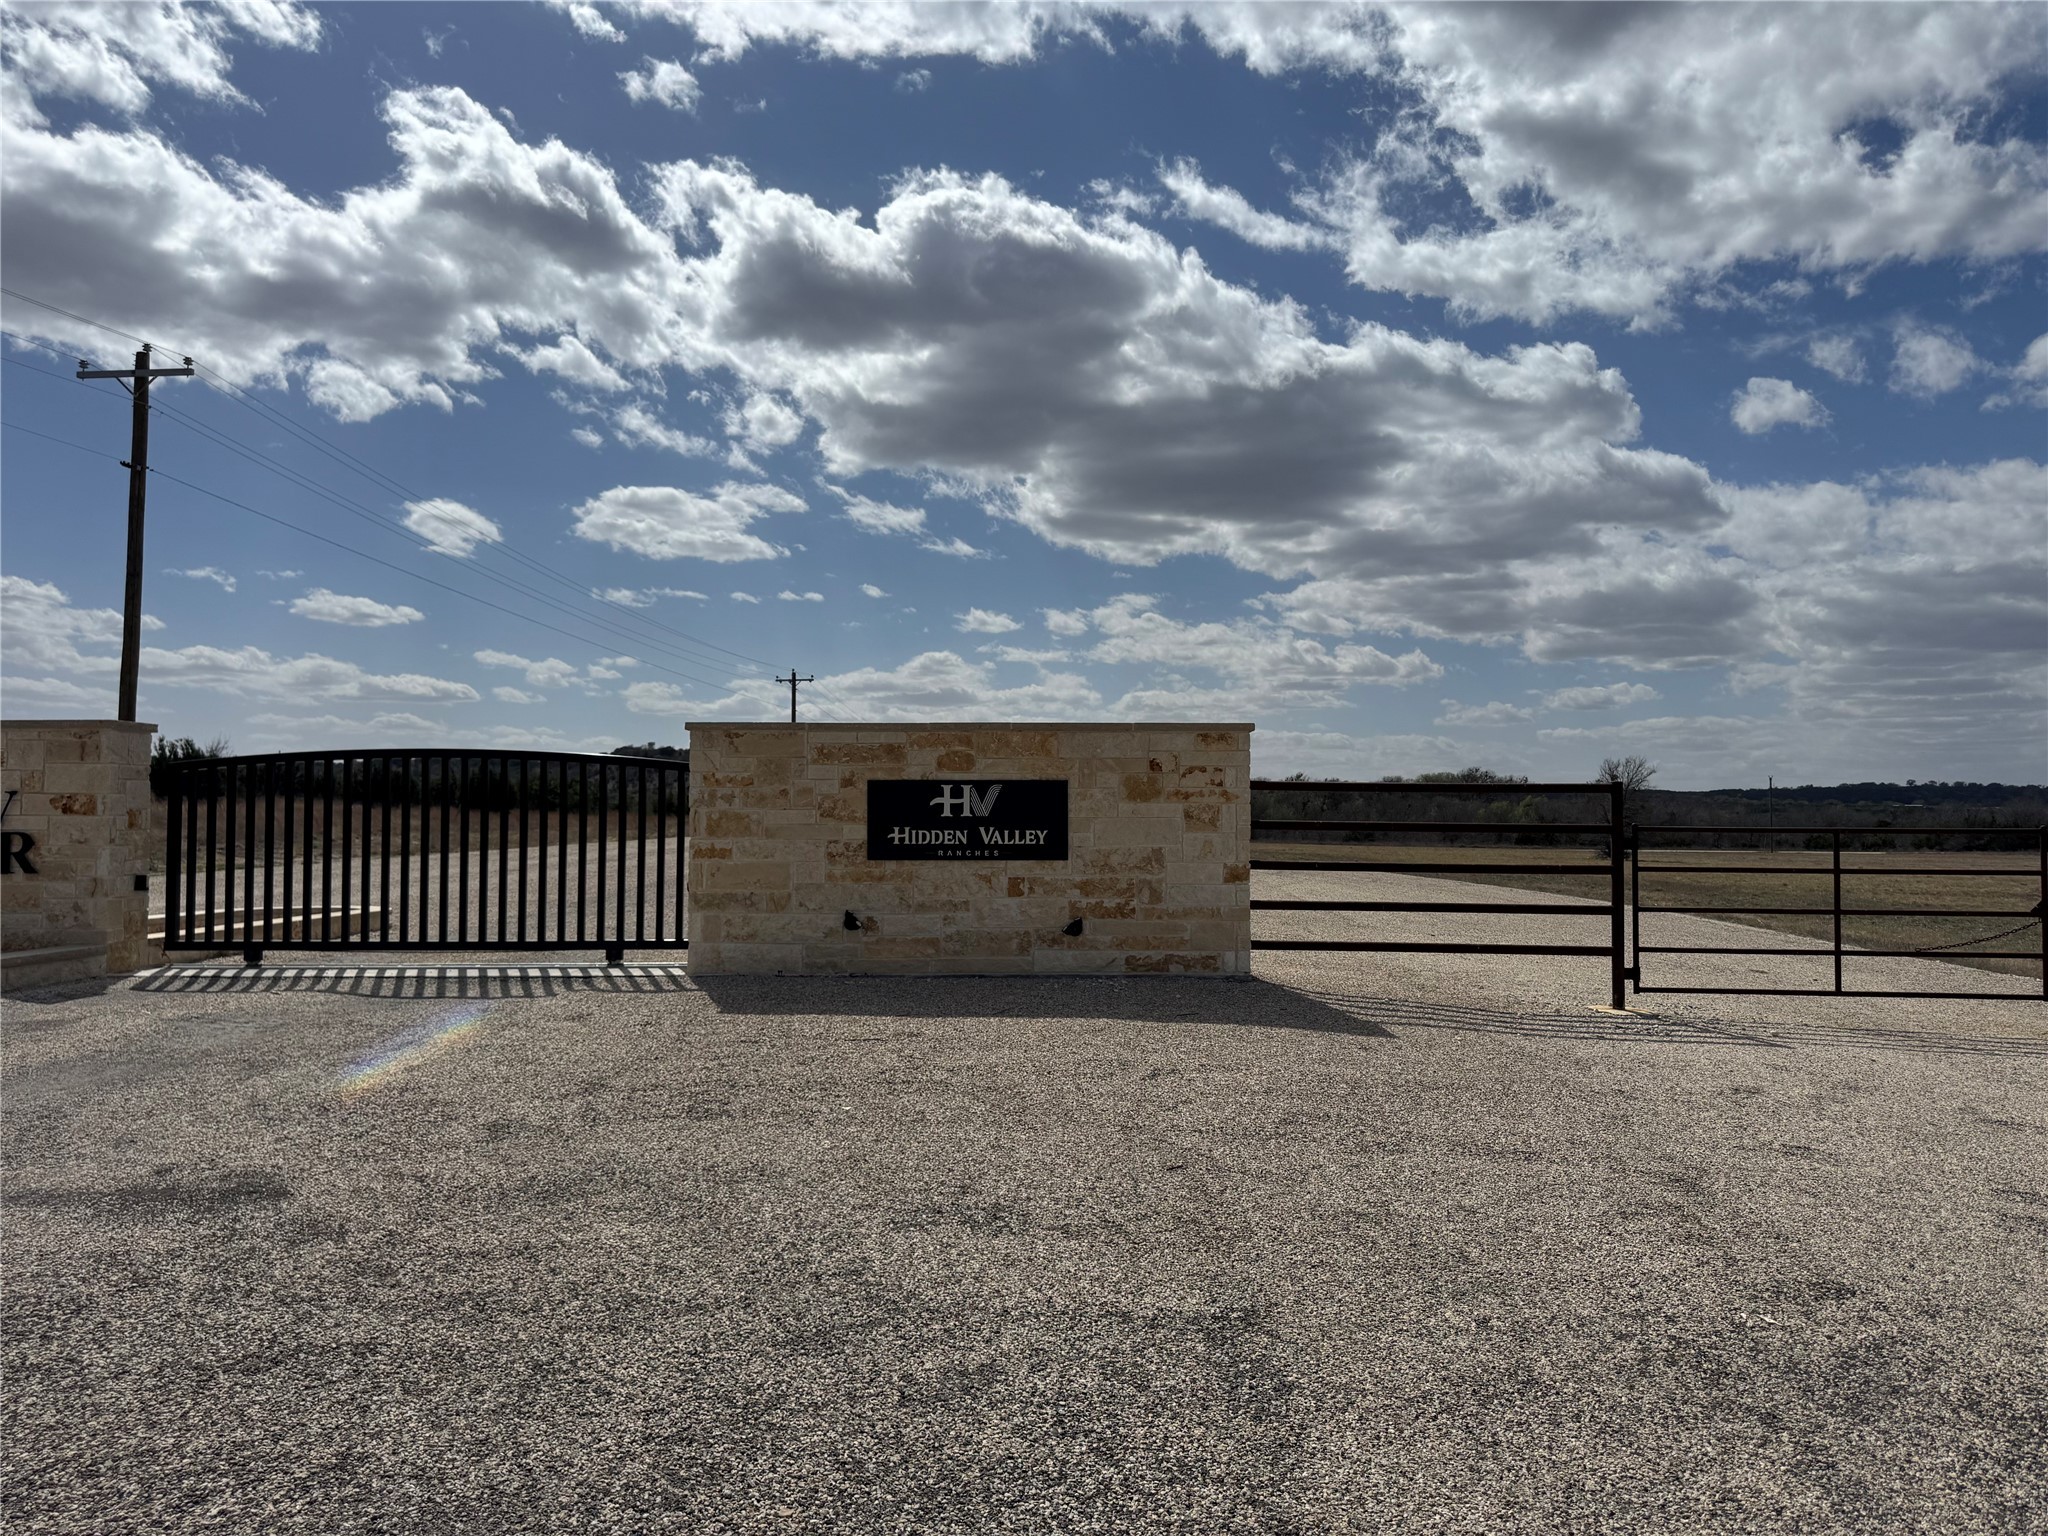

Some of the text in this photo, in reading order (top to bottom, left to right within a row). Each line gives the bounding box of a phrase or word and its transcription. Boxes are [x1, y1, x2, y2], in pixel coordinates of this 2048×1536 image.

[930, 784, 1003, 817] HV
[887, 827, 1048, 845] HIDDEN VALLEY
